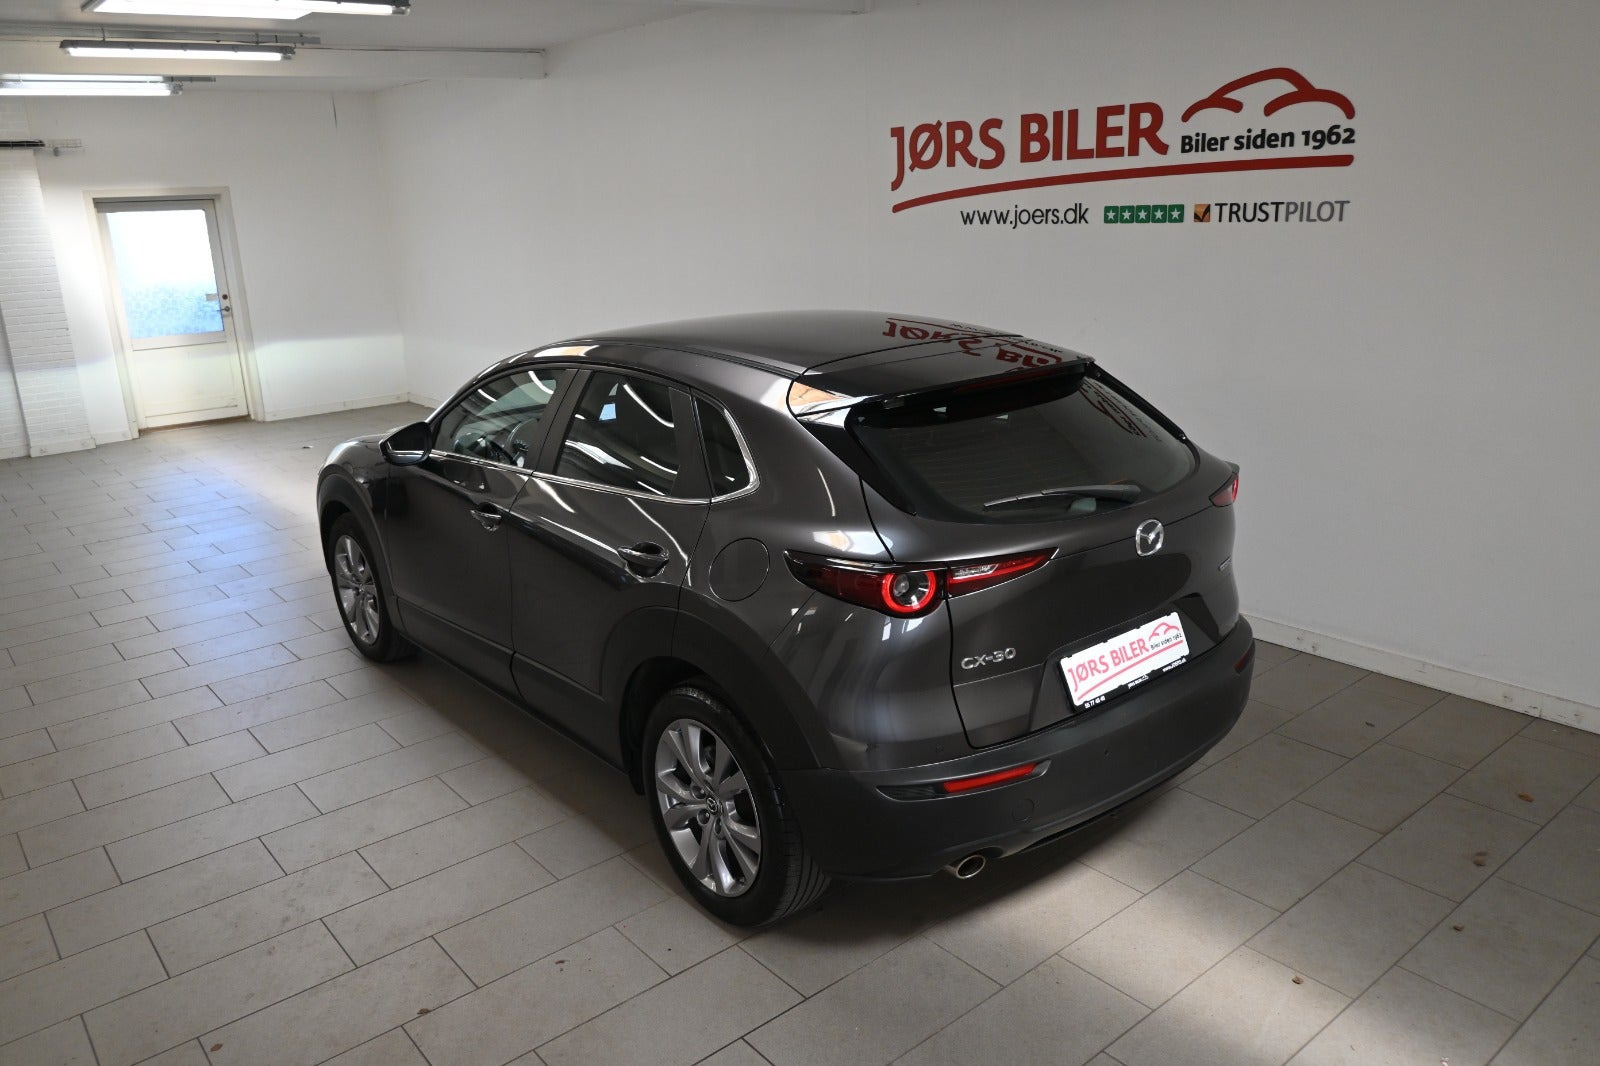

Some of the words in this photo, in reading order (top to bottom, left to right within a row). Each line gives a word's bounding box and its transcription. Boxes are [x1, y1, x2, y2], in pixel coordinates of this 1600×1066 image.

[890, 120, 1005, 191] JØRS
[1020, 102, 1169, 163] BILER
[1181, 132, 1229, 153] Biler
[1234, 128, 1294, 150] siden
[1302, 125, 1355, 150] 1962
[960, 203, 1089, 229] www.joers.dk
[1215, 200, 1350, 222] TRUSTPILOT
[961, 647, 1016, 669] CX-30
[1067, 654, 1109, 693] JØRS
[1109, 638, 1150, 667] BILER
